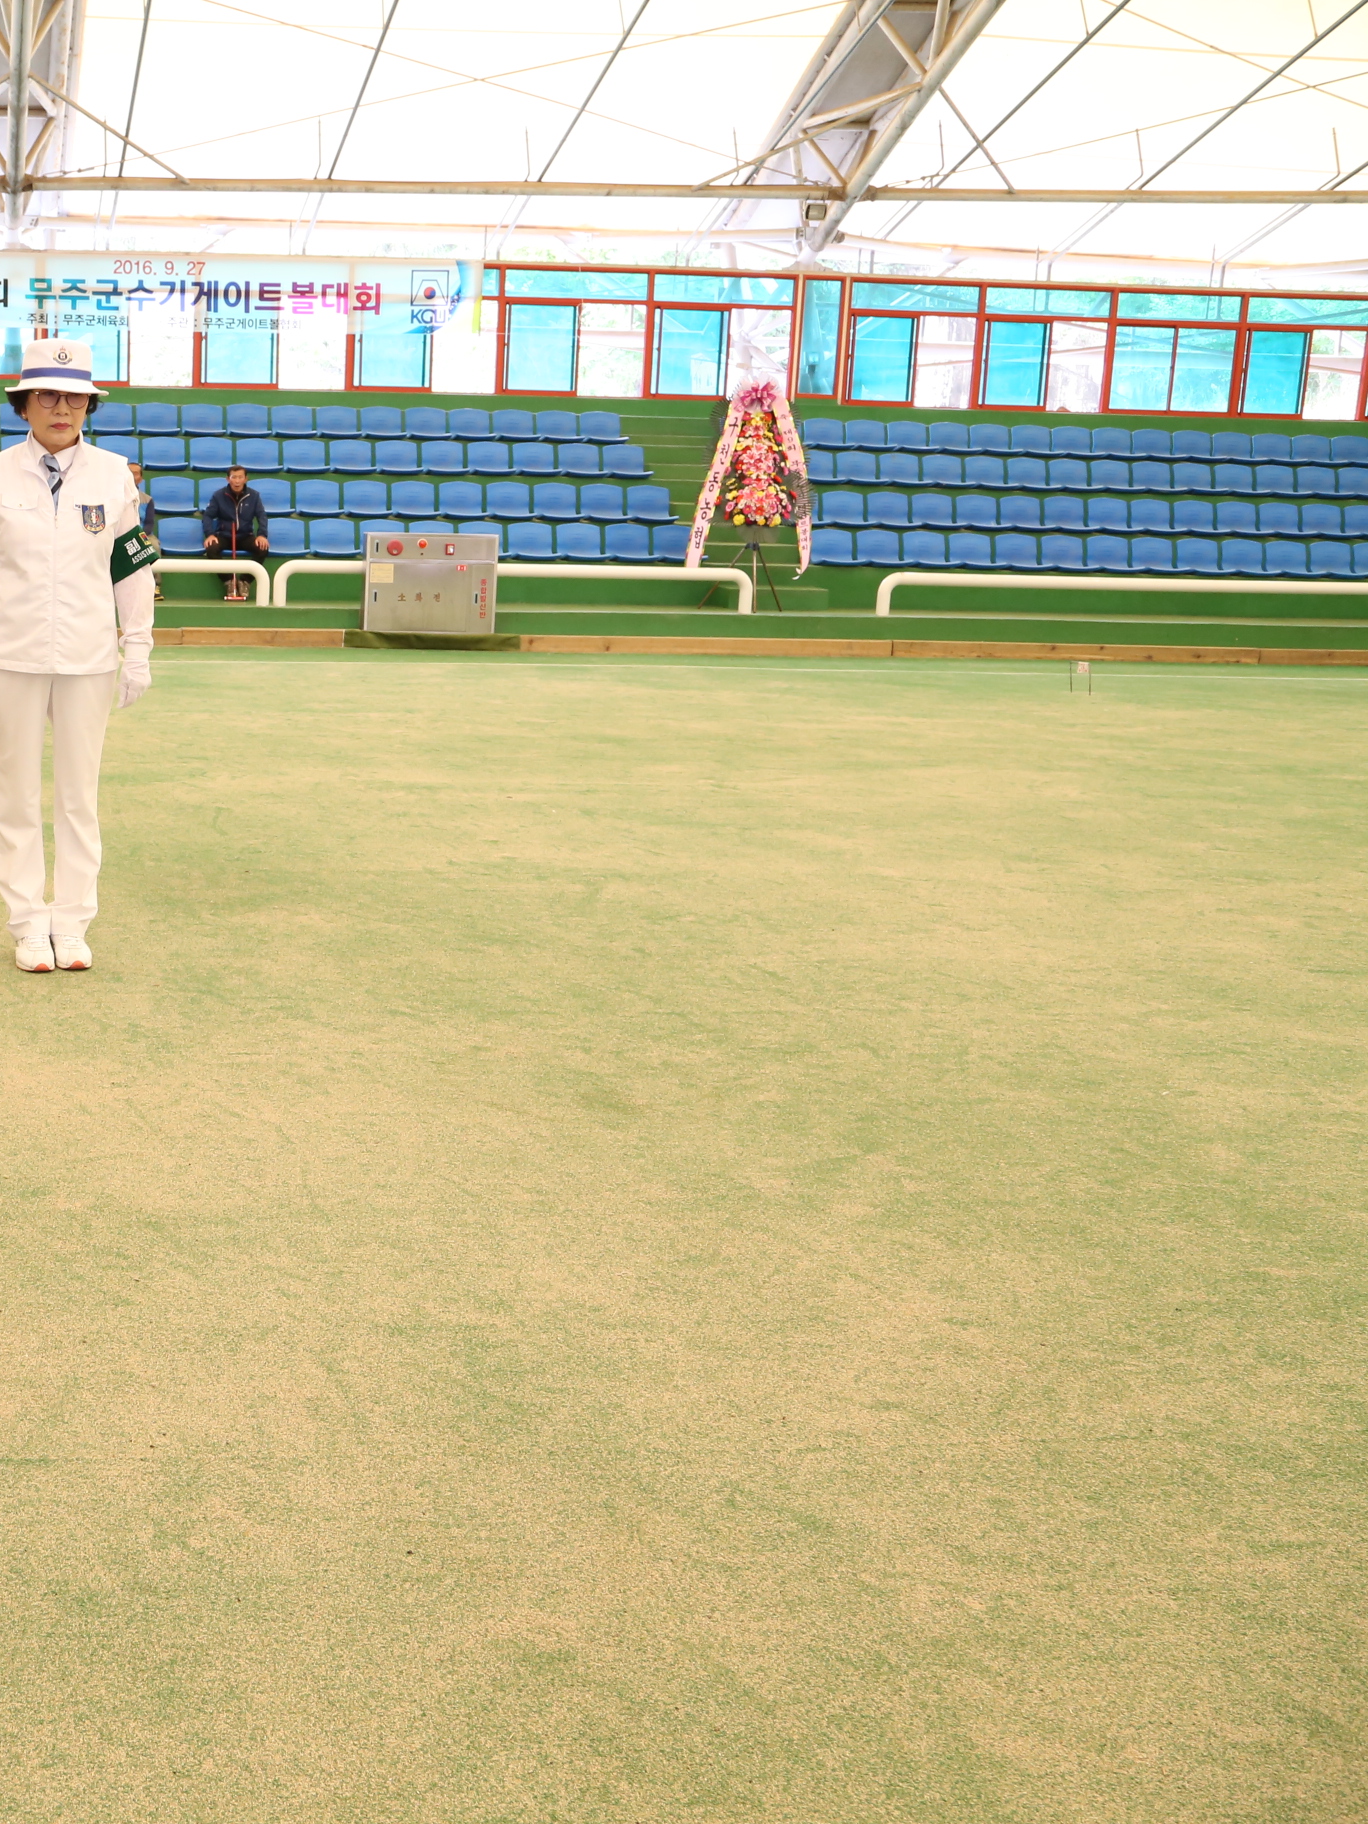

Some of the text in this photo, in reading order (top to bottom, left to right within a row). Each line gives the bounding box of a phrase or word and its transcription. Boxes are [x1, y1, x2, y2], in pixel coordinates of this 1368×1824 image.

[186, 260, 206, 276] 27
[25, 277, 381, 316] 무주군수기게이트볼대회
[26, 313, 49, 325] 주최
[62, 314, 130, 327] 무주군체육회
[410, 308, 446, 324] KGU
